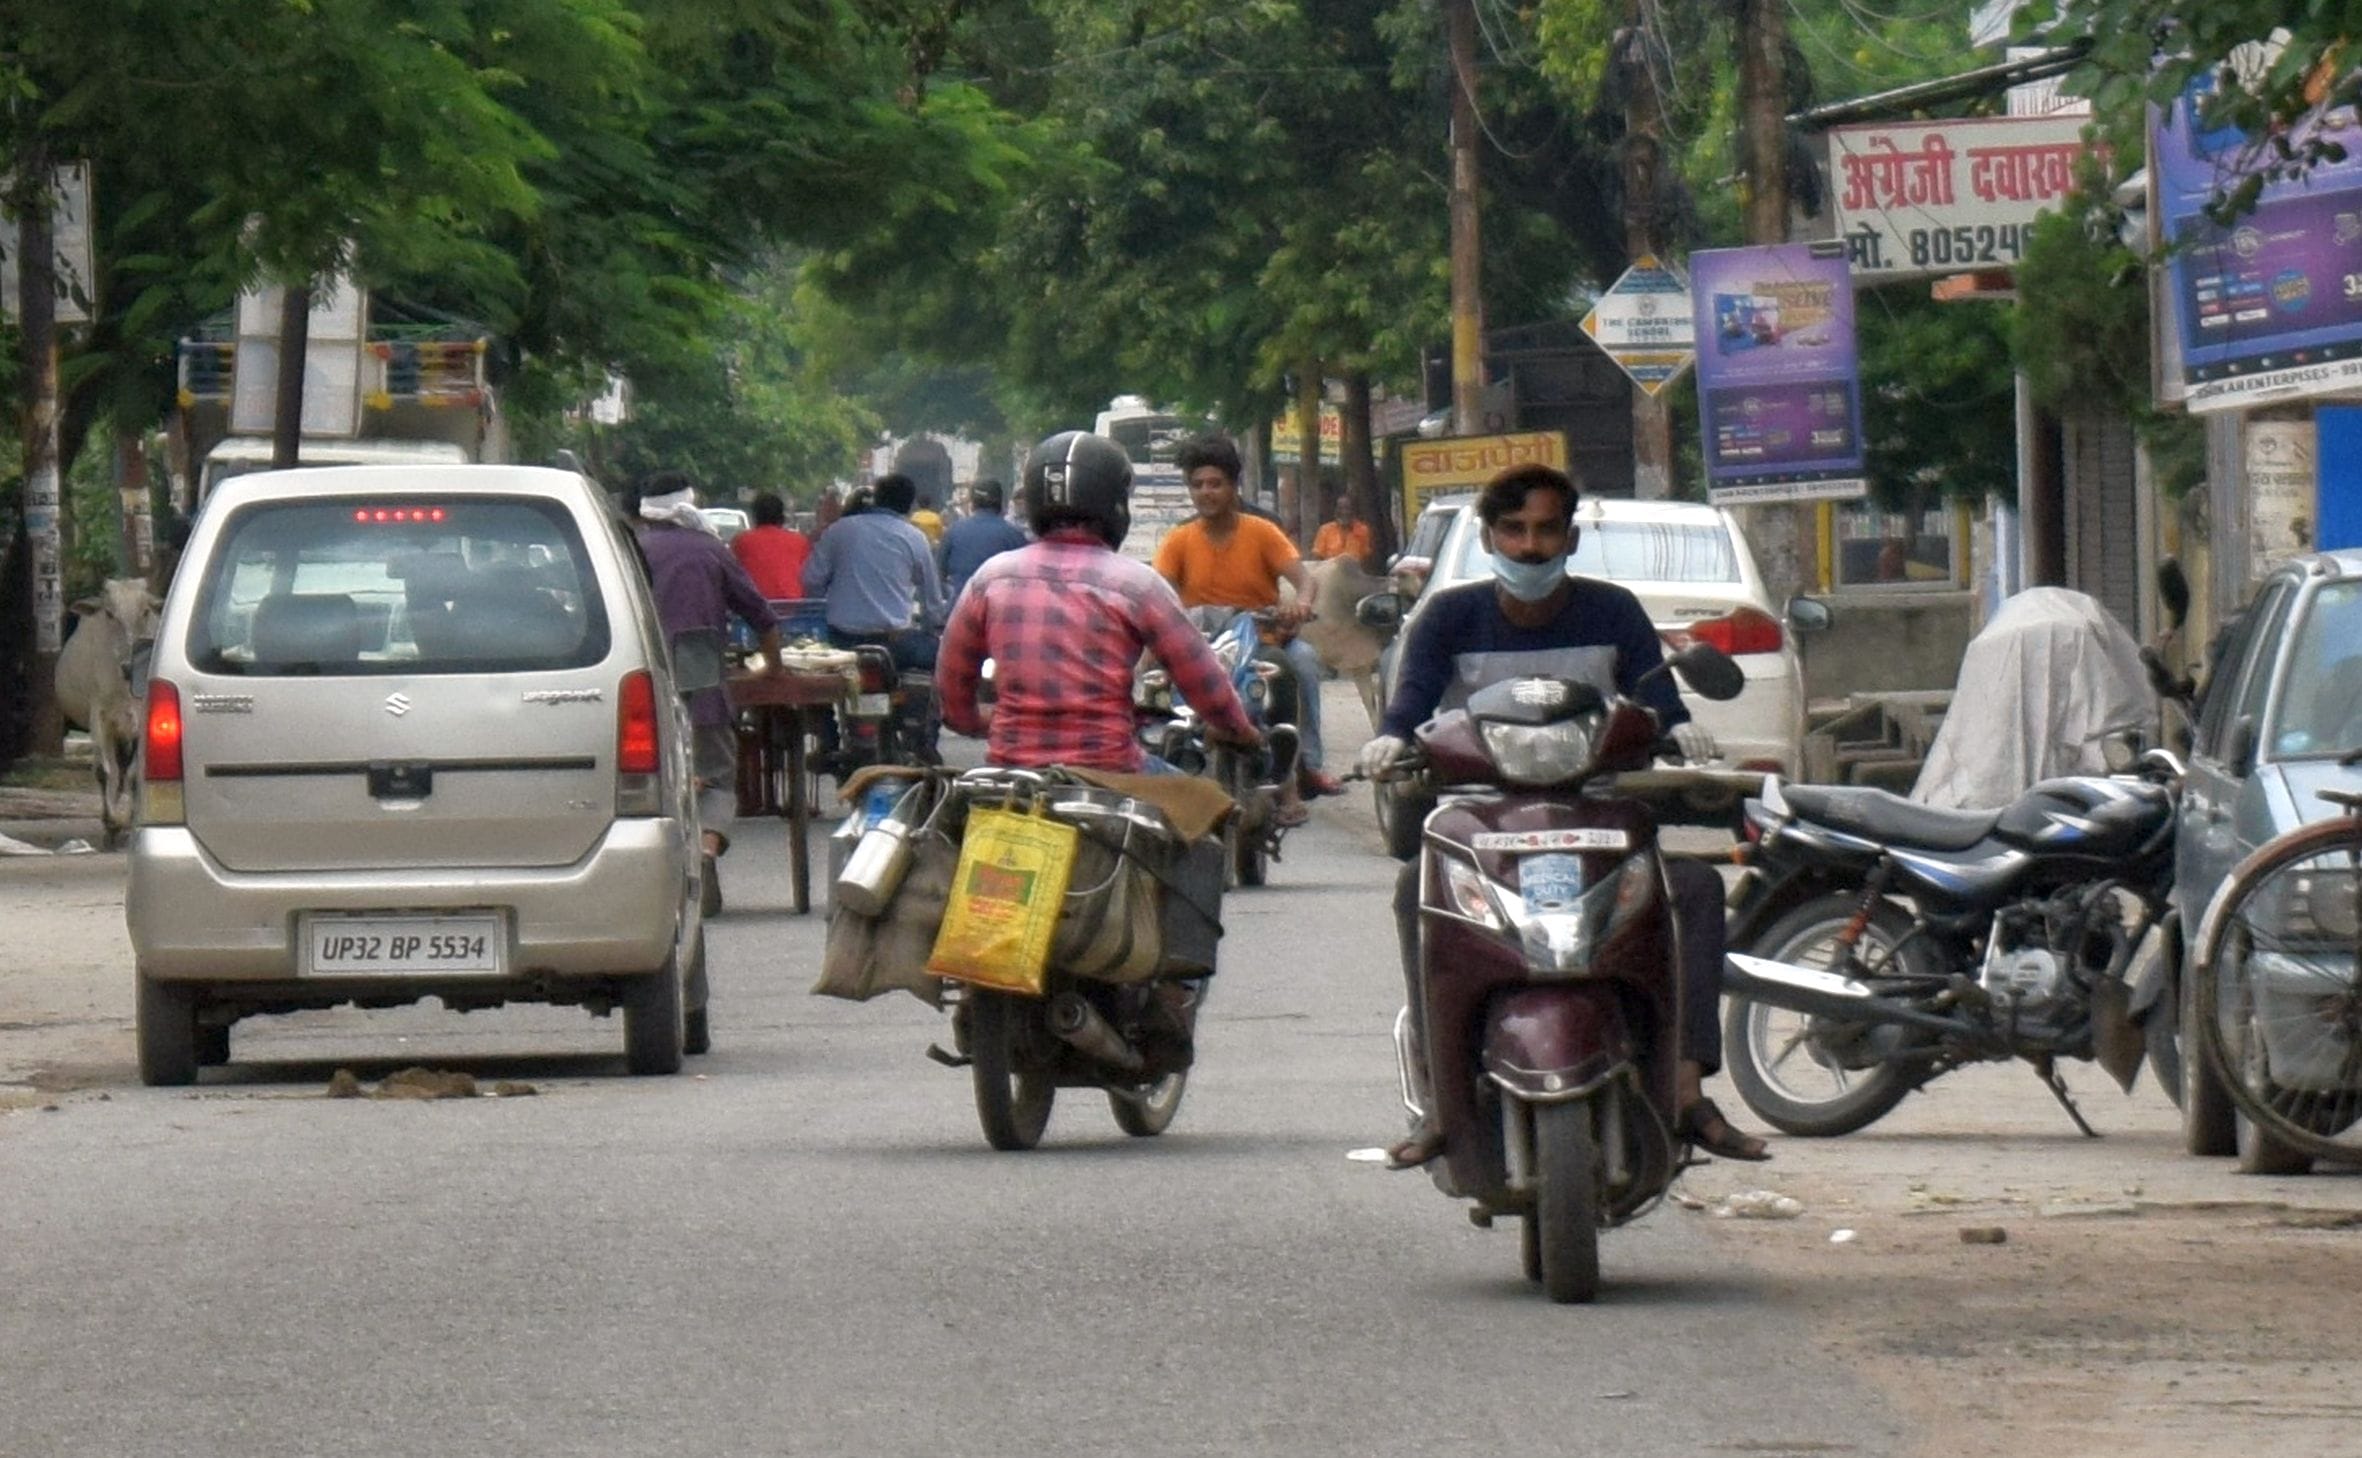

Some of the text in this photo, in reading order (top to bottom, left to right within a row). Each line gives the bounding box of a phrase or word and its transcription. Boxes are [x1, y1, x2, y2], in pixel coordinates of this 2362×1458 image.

[322, 935, 485, 960] UP32 BP 5534
